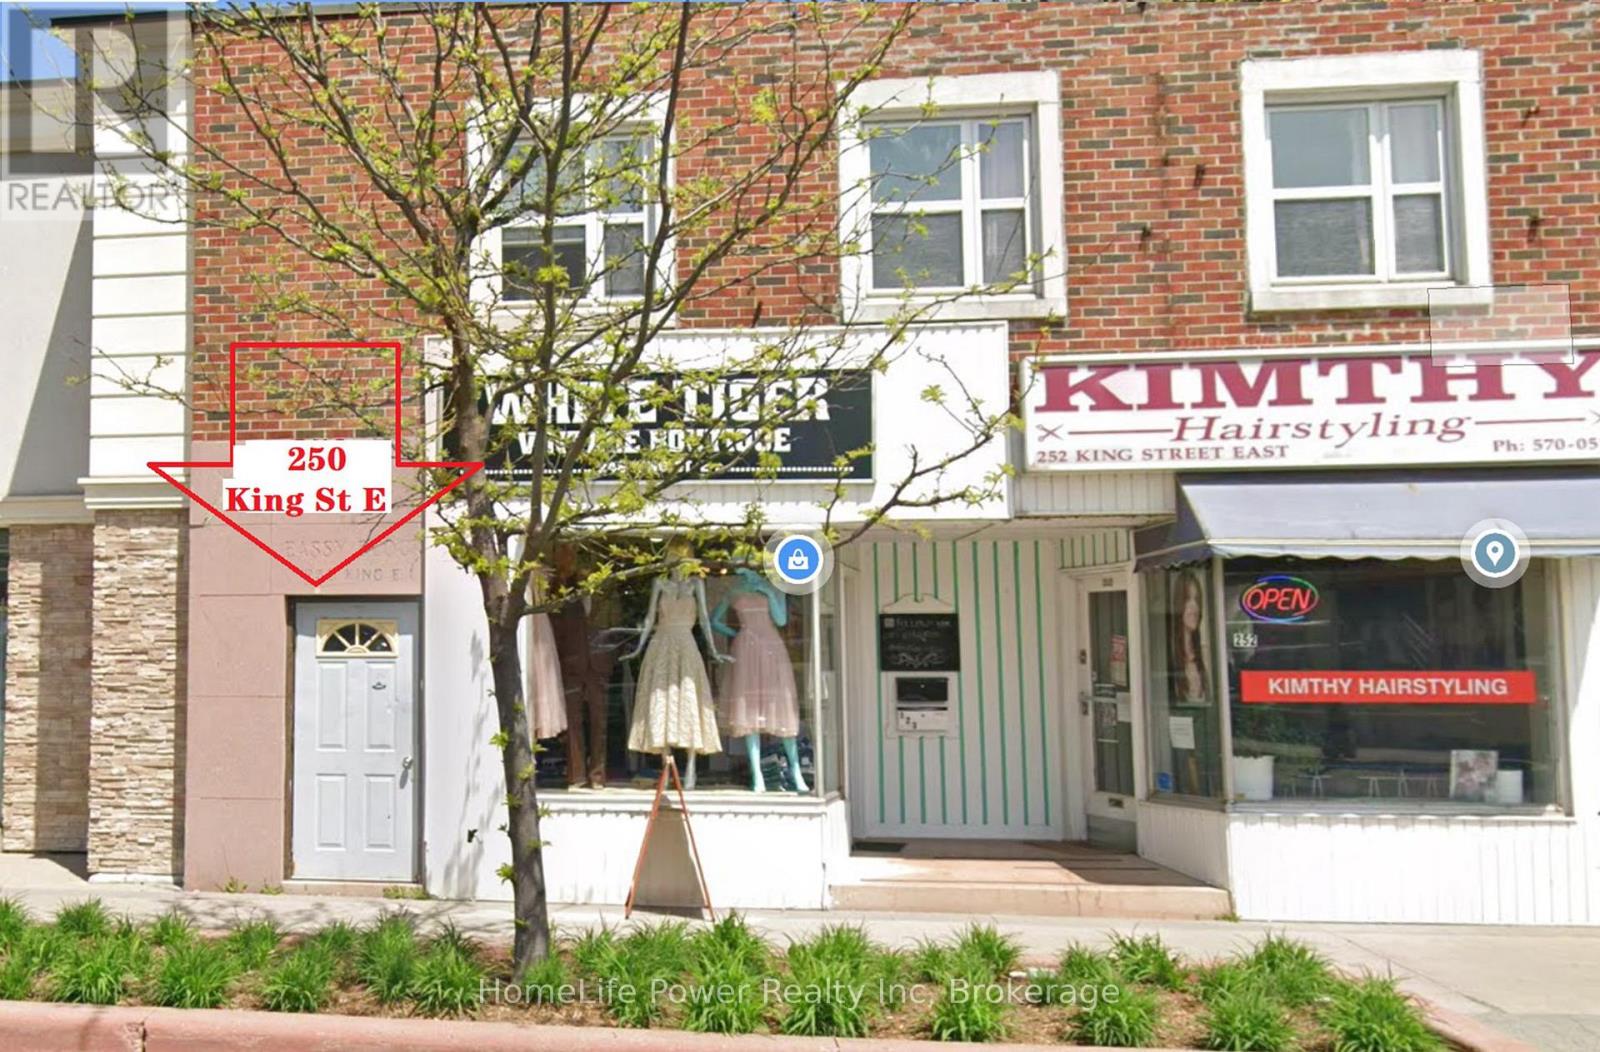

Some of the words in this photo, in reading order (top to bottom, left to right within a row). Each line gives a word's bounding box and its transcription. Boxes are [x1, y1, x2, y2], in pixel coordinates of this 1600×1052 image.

[1035, 347, 1600, 412] KIMTHY
[1170, 411, 1472, 449] Hairstyling
[1037, 450, 1068, 463] 252
[1076, 448, 1133, 462] KING
[1142, 446, 1224, 461] STREET
[1233, 445, 1290, 460] EAST
[1492, 439, 1526, 453] Ph:
[1245, 587, 1312, 611] OPEN
[1268, 678, 1352, 695] KIMTHY
[1359, 677, 1508, 695] HAIRSTYLING
